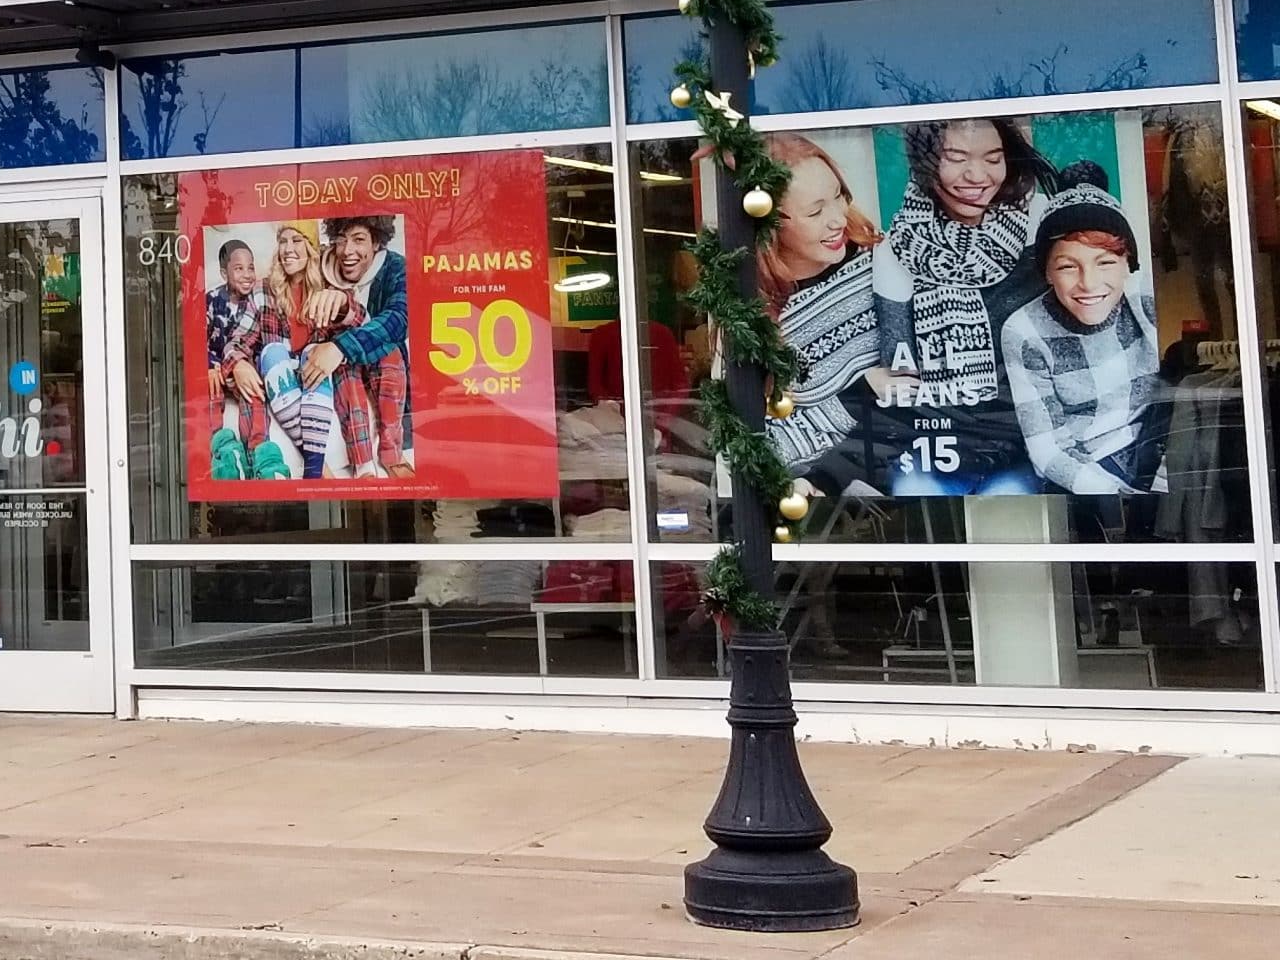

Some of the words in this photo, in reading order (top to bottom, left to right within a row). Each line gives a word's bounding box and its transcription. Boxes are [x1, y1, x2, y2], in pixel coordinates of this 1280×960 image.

[255, 176, 358, 208] TODAY
[369, 168, 461, 201] ONLY!
[138, 234, 192, 265] 840
[423, 250, 533, 273] PAJAMAS
[453, 286, 470, 294] FOR
[472, 285, 487, 293] THE
[488, 284, 506, 292] FAM
[428, 298, 532, 376] 50
[890, 340, 961, 371] ALL
[21, 369, 36, 385] IN
[483, 376, 521, 395] OFF
[876, 381, 981, 408] JEANS
[914, 418, 952, 430] FROM
[899, 435, 961, 475] $15
